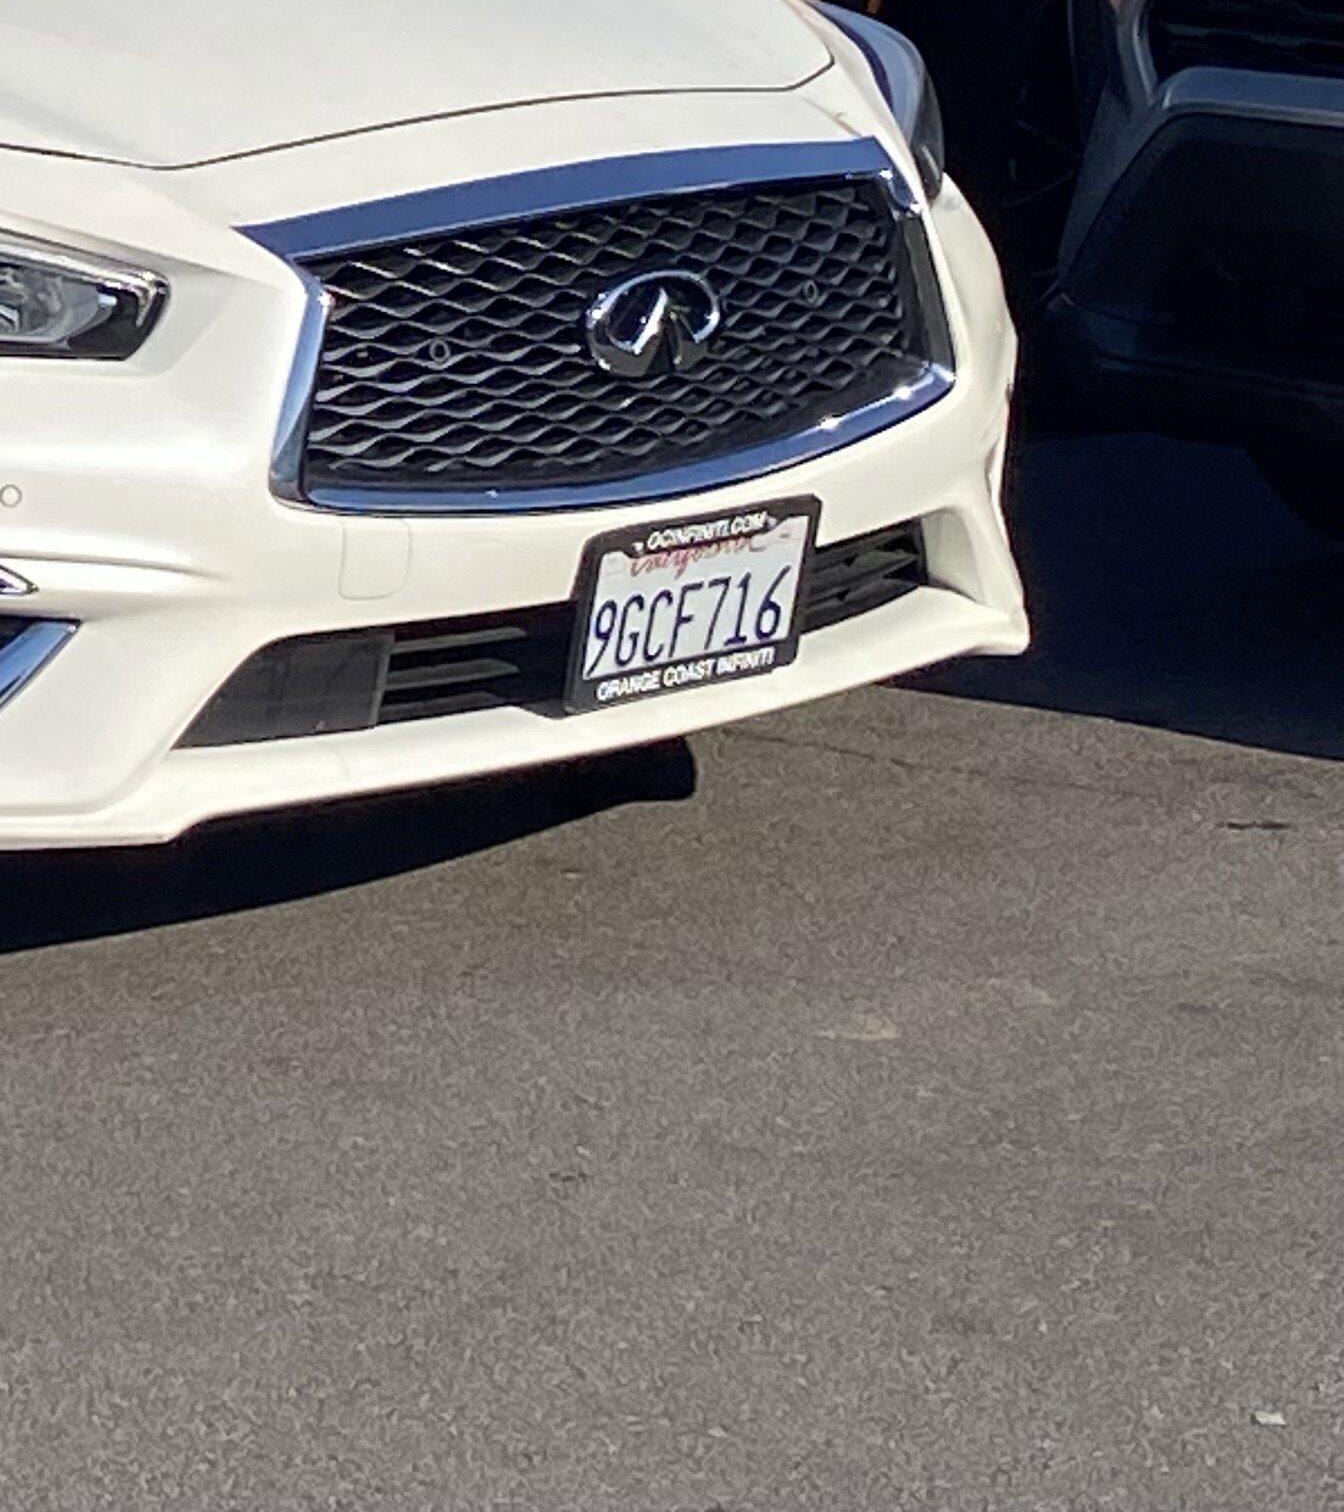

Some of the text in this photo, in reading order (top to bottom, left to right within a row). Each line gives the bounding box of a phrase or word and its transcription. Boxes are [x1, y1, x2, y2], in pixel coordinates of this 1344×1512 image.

[587, 565, 791, 676] 9GCF716
[596, 647, 776, 701] ORANGE COAST INFINITI
